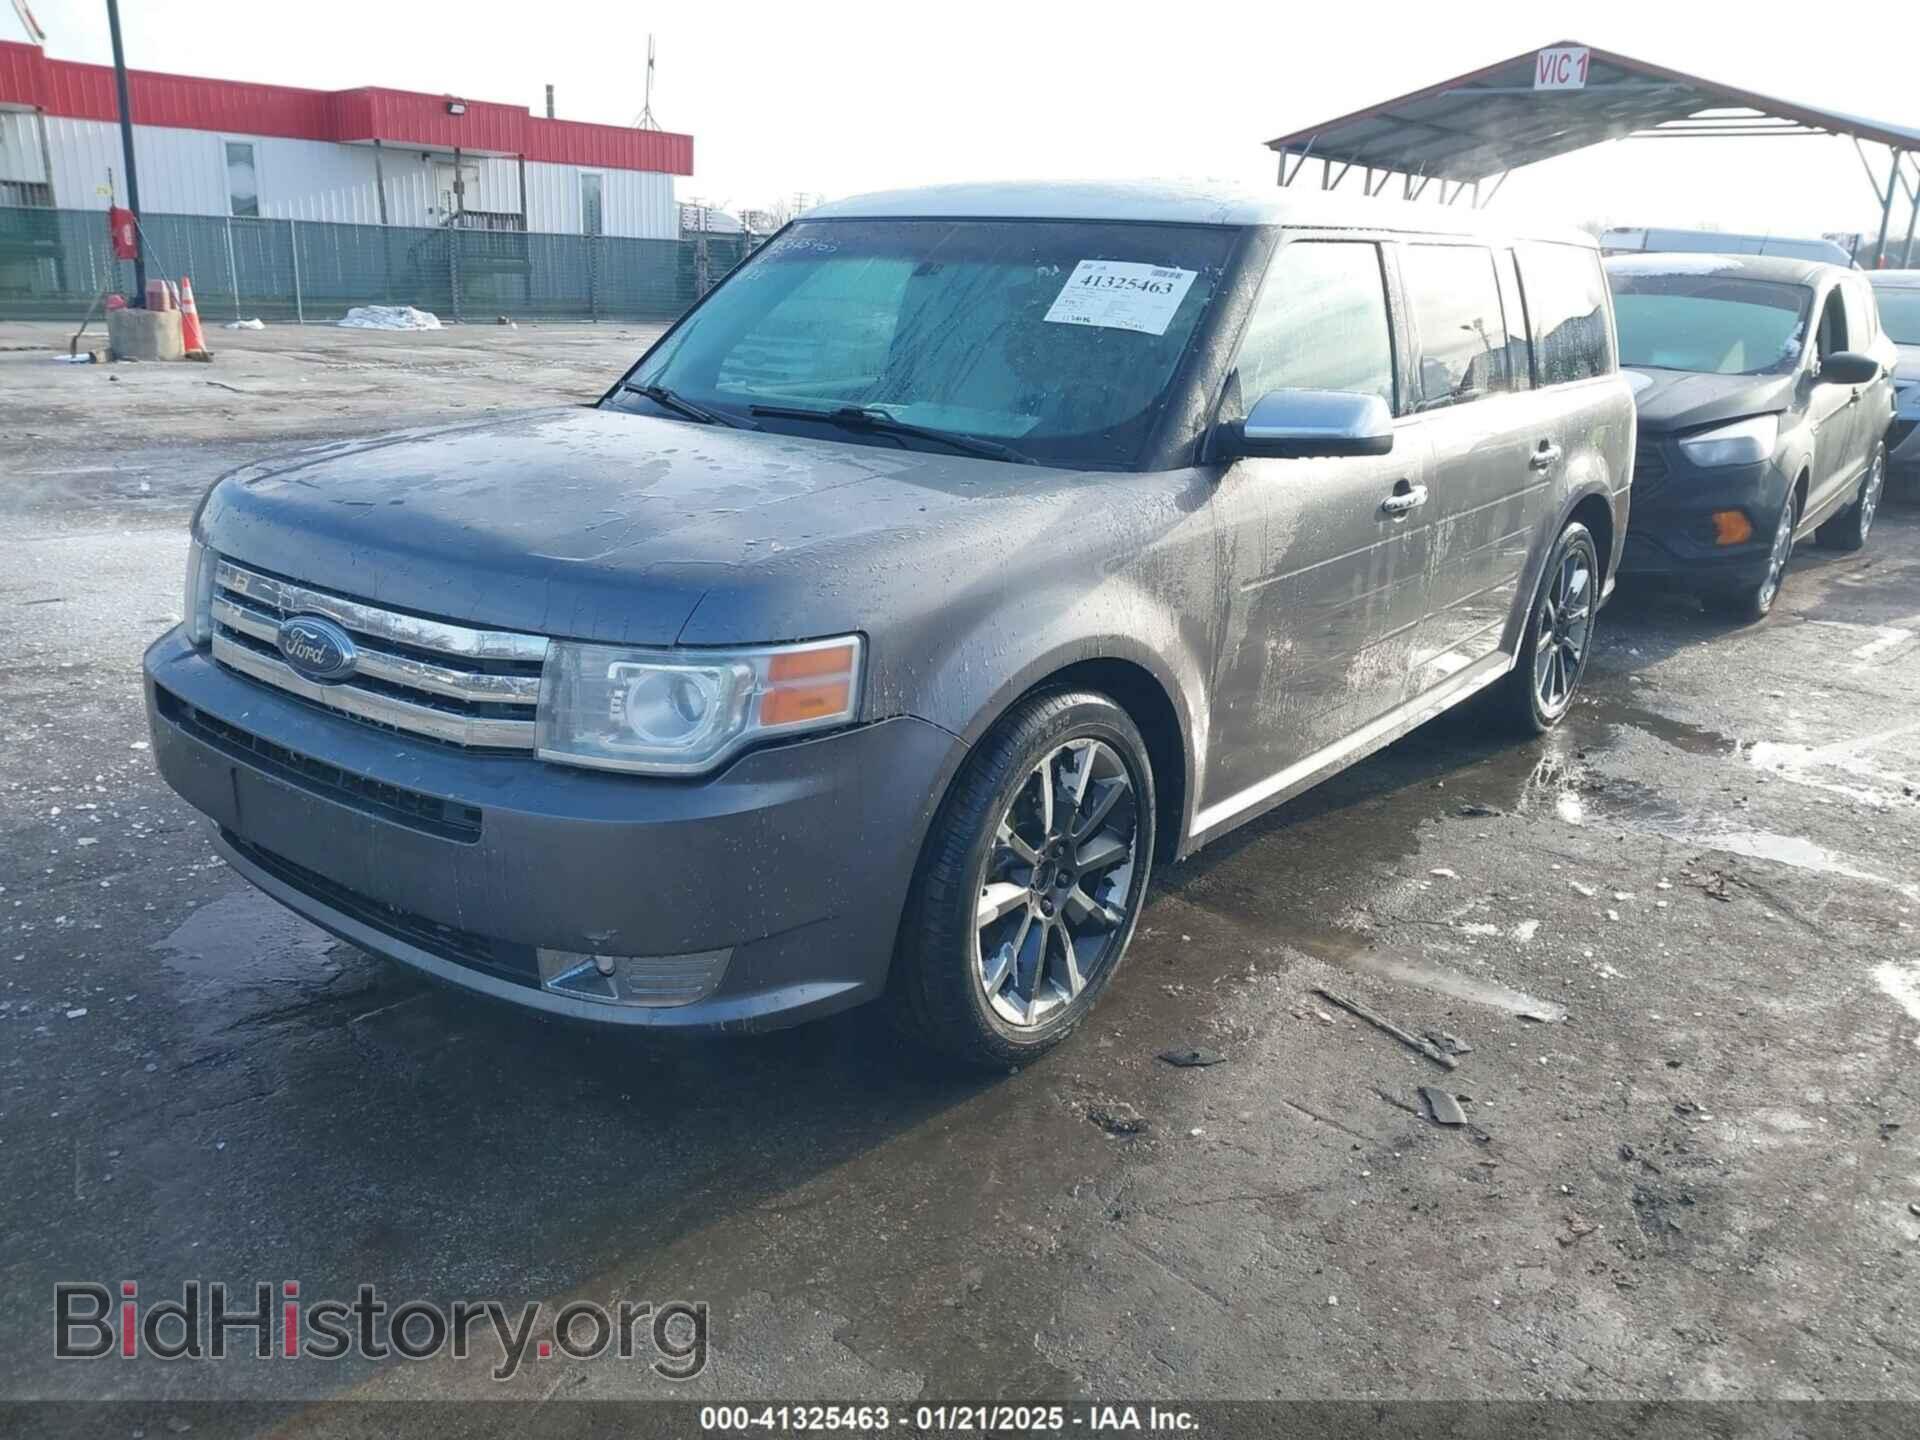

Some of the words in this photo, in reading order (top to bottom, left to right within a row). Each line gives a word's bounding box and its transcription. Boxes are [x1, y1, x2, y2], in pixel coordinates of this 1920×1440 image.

[1540, 53, 1572, 84] VIC
[1577, 53, 1588, 83] 1
[1080, 274, 1174, 295] 41325463
[286, 626, 327, 664] Ford
